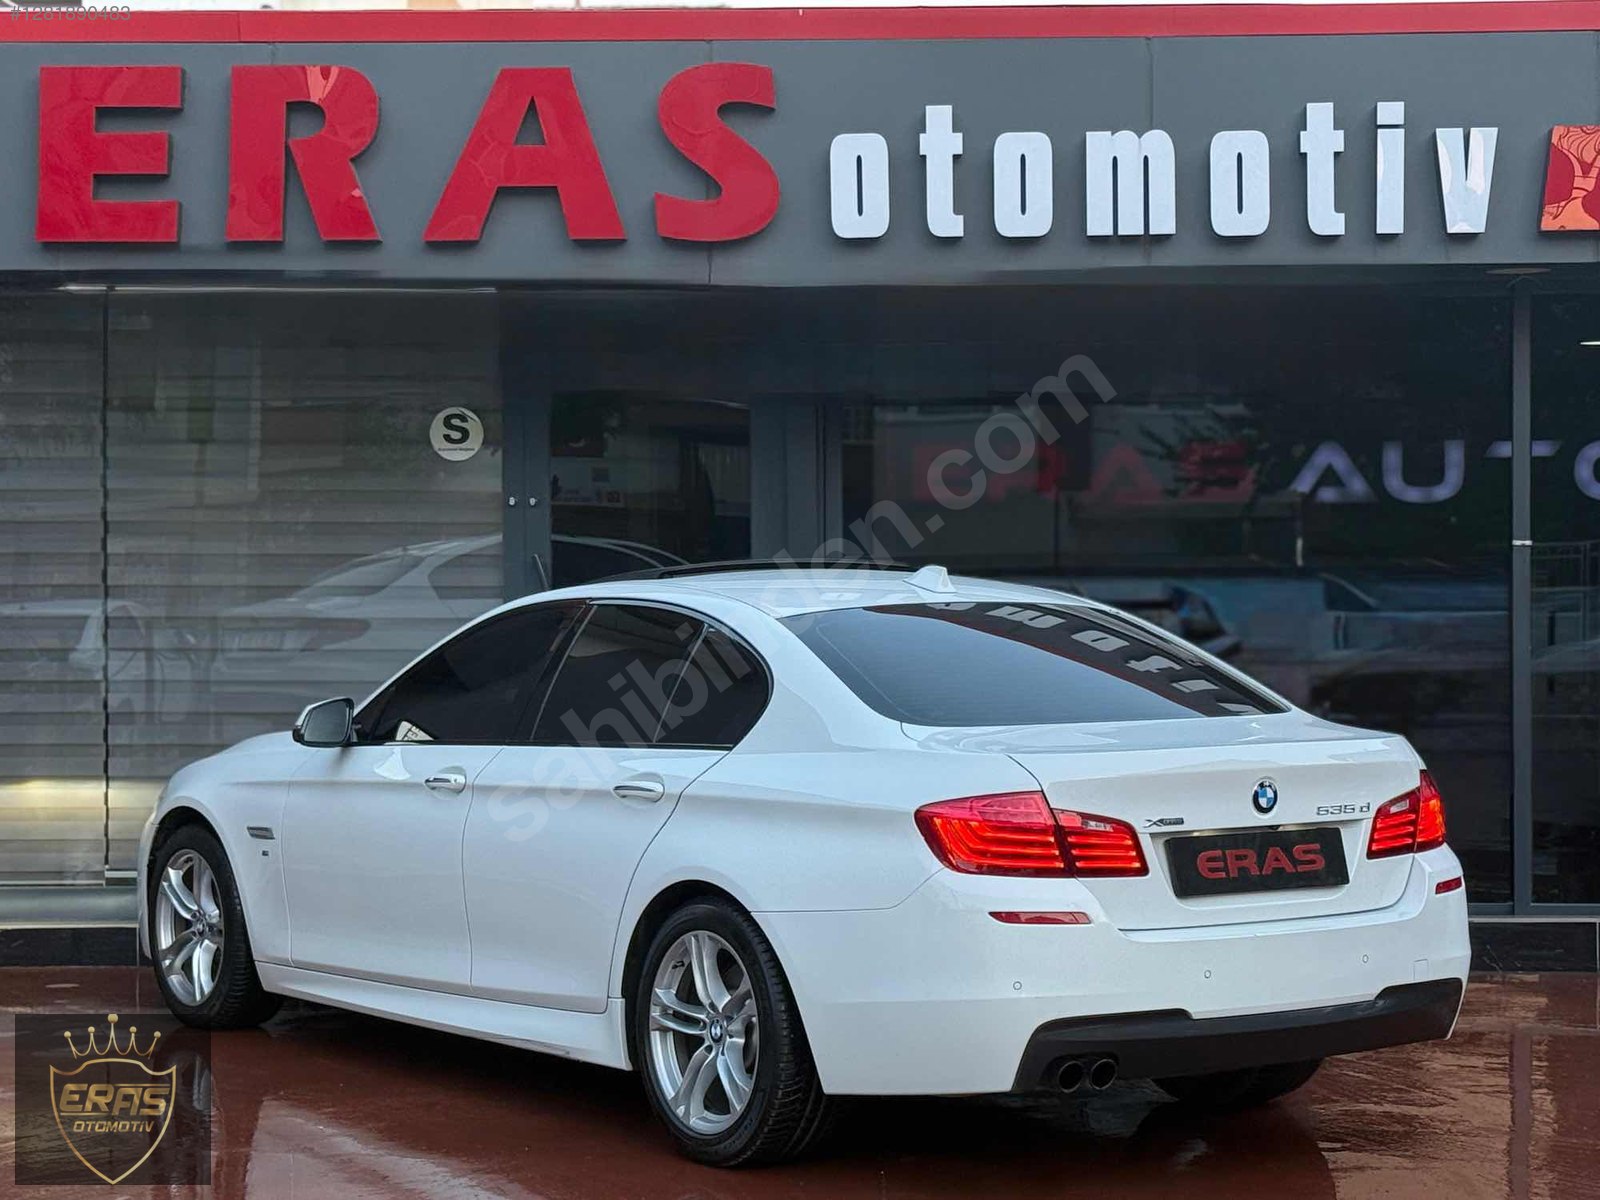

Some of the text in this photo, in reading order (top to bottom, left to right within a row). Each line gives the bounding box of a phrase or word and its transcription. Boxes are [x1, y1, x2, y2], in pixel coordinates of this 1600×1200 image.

[36, 62, 1499, 243] ERAS otomotiv
[1196, 843, 1325, 879] ERAS
